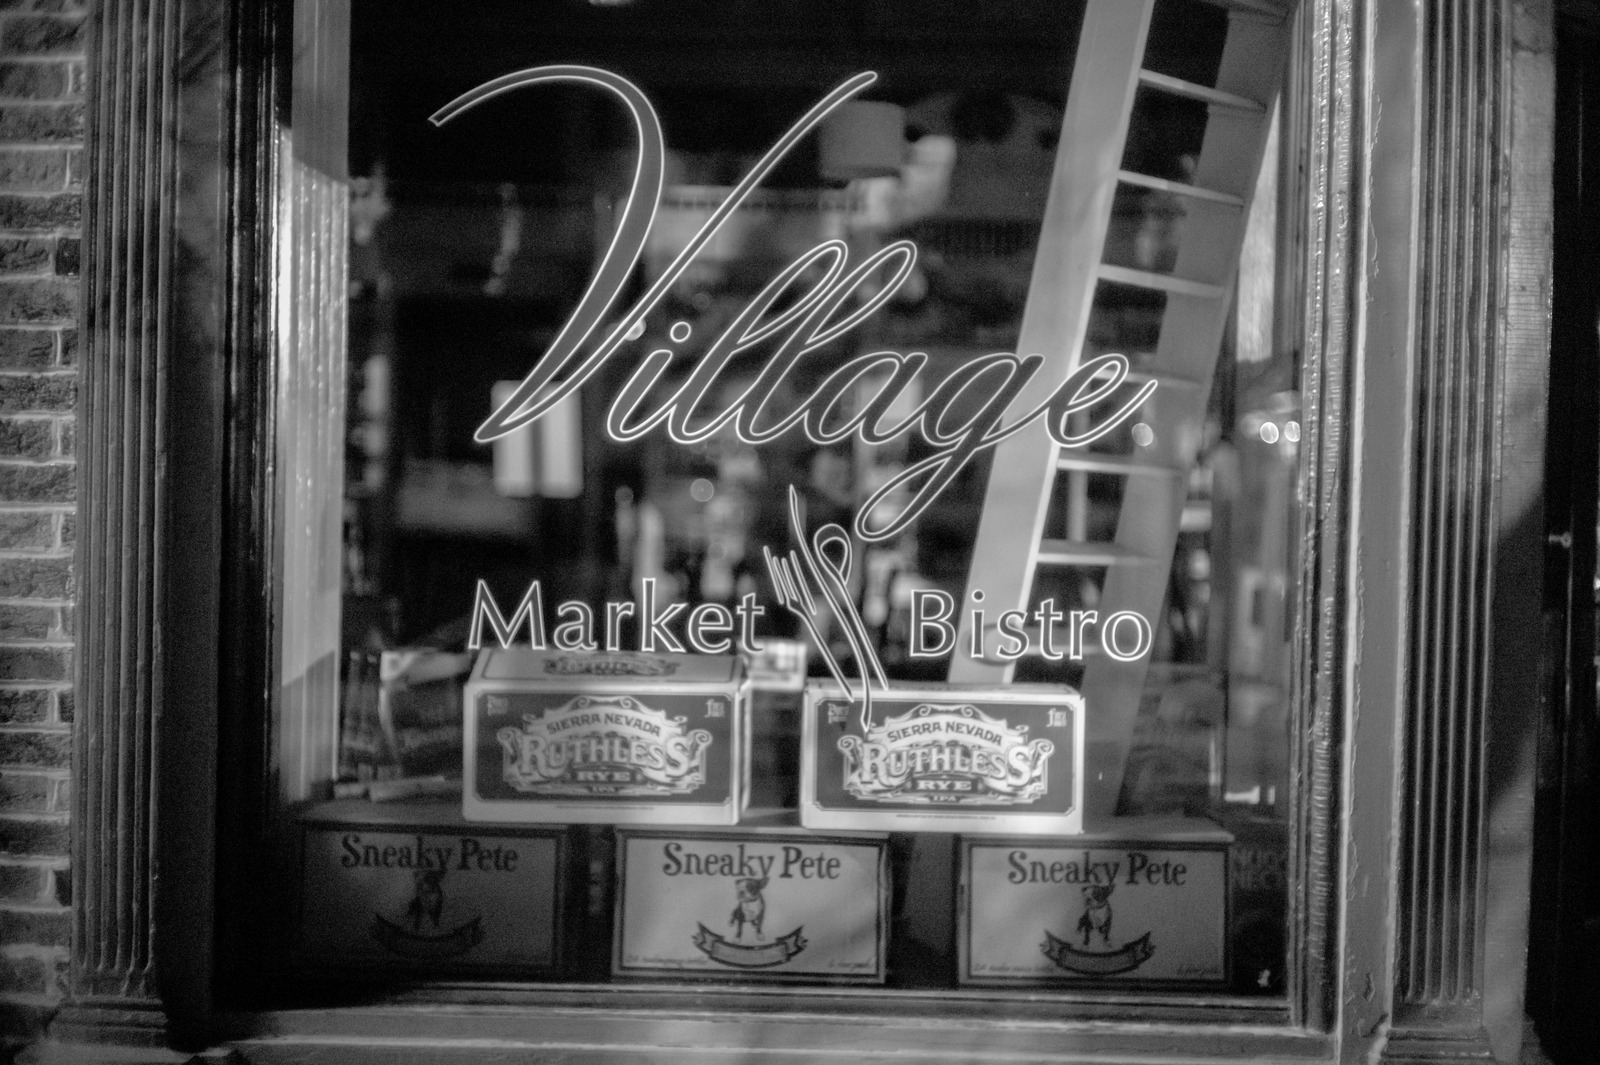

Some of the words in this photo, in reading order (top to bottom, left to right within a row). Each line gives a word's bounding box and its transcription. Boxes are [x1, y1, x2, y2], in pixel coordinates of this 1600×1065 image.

[428, 64, 1158, 541] Village
[467, 577, 765, 653] Market
[909, 588, 1154, 662] Bistro
[546, 713, 601, 734] SIERRA
[604, 712, 662, 737] NEVADA
[887, 721, 943, 743] SIERRA
[945, 721, 1003, 746] NEVADA
[577, 770, 631, 782] RYE
[916, 780, 973, 791] RYE
[932, 794, 958, 803] IPA
[341, 834, 452, 868] Sneaky
[457, 838, 519, 872] Pete
[662, 841, 775, 878] Sneaky
[780, 846, 841, 879] Pete
[1007, 850, 1121, 885] Sneaky
[1125, 852, 1188, 886] Pete
